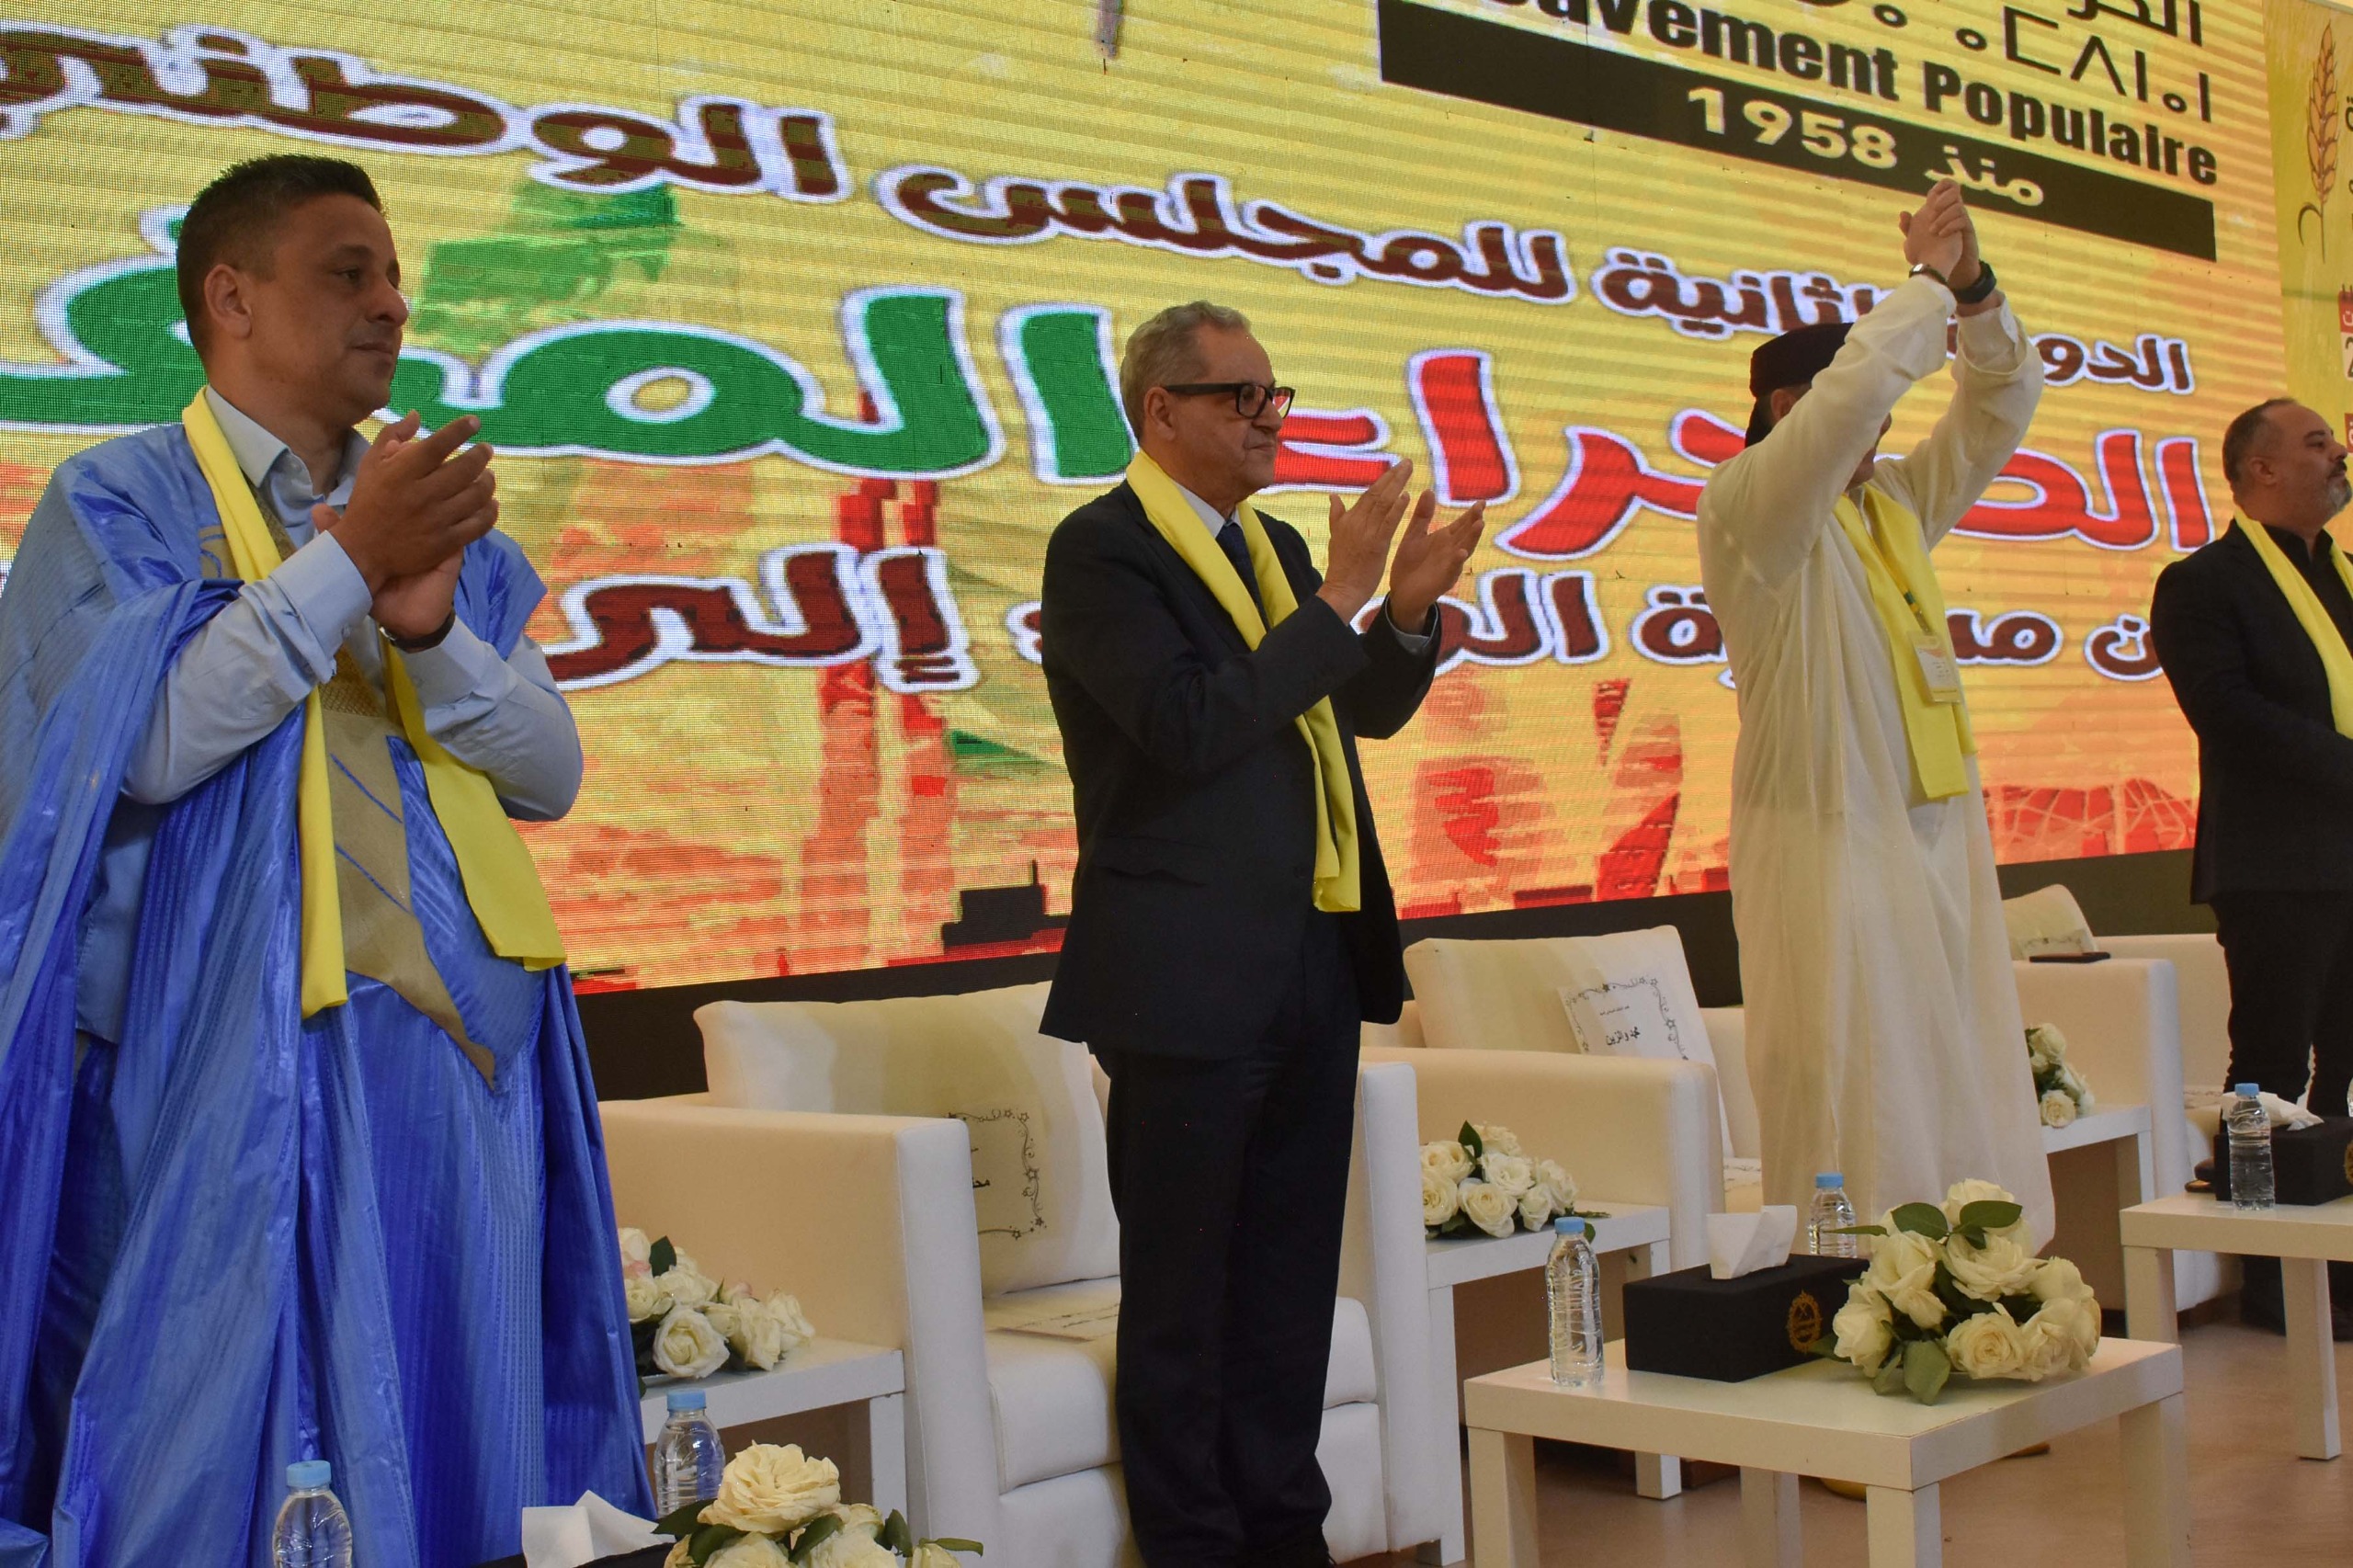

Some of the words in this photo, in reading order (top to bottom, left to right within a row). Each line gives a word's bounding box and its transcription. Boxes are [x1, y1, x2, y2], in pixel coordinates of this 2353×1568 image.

[1687, 85, 1899, 170] 1958
[1921, 59, 2219, 186] Populaire
[1925, 143, 2045, 208] منذ
[884, 168, 1568, 300] للمجلس
